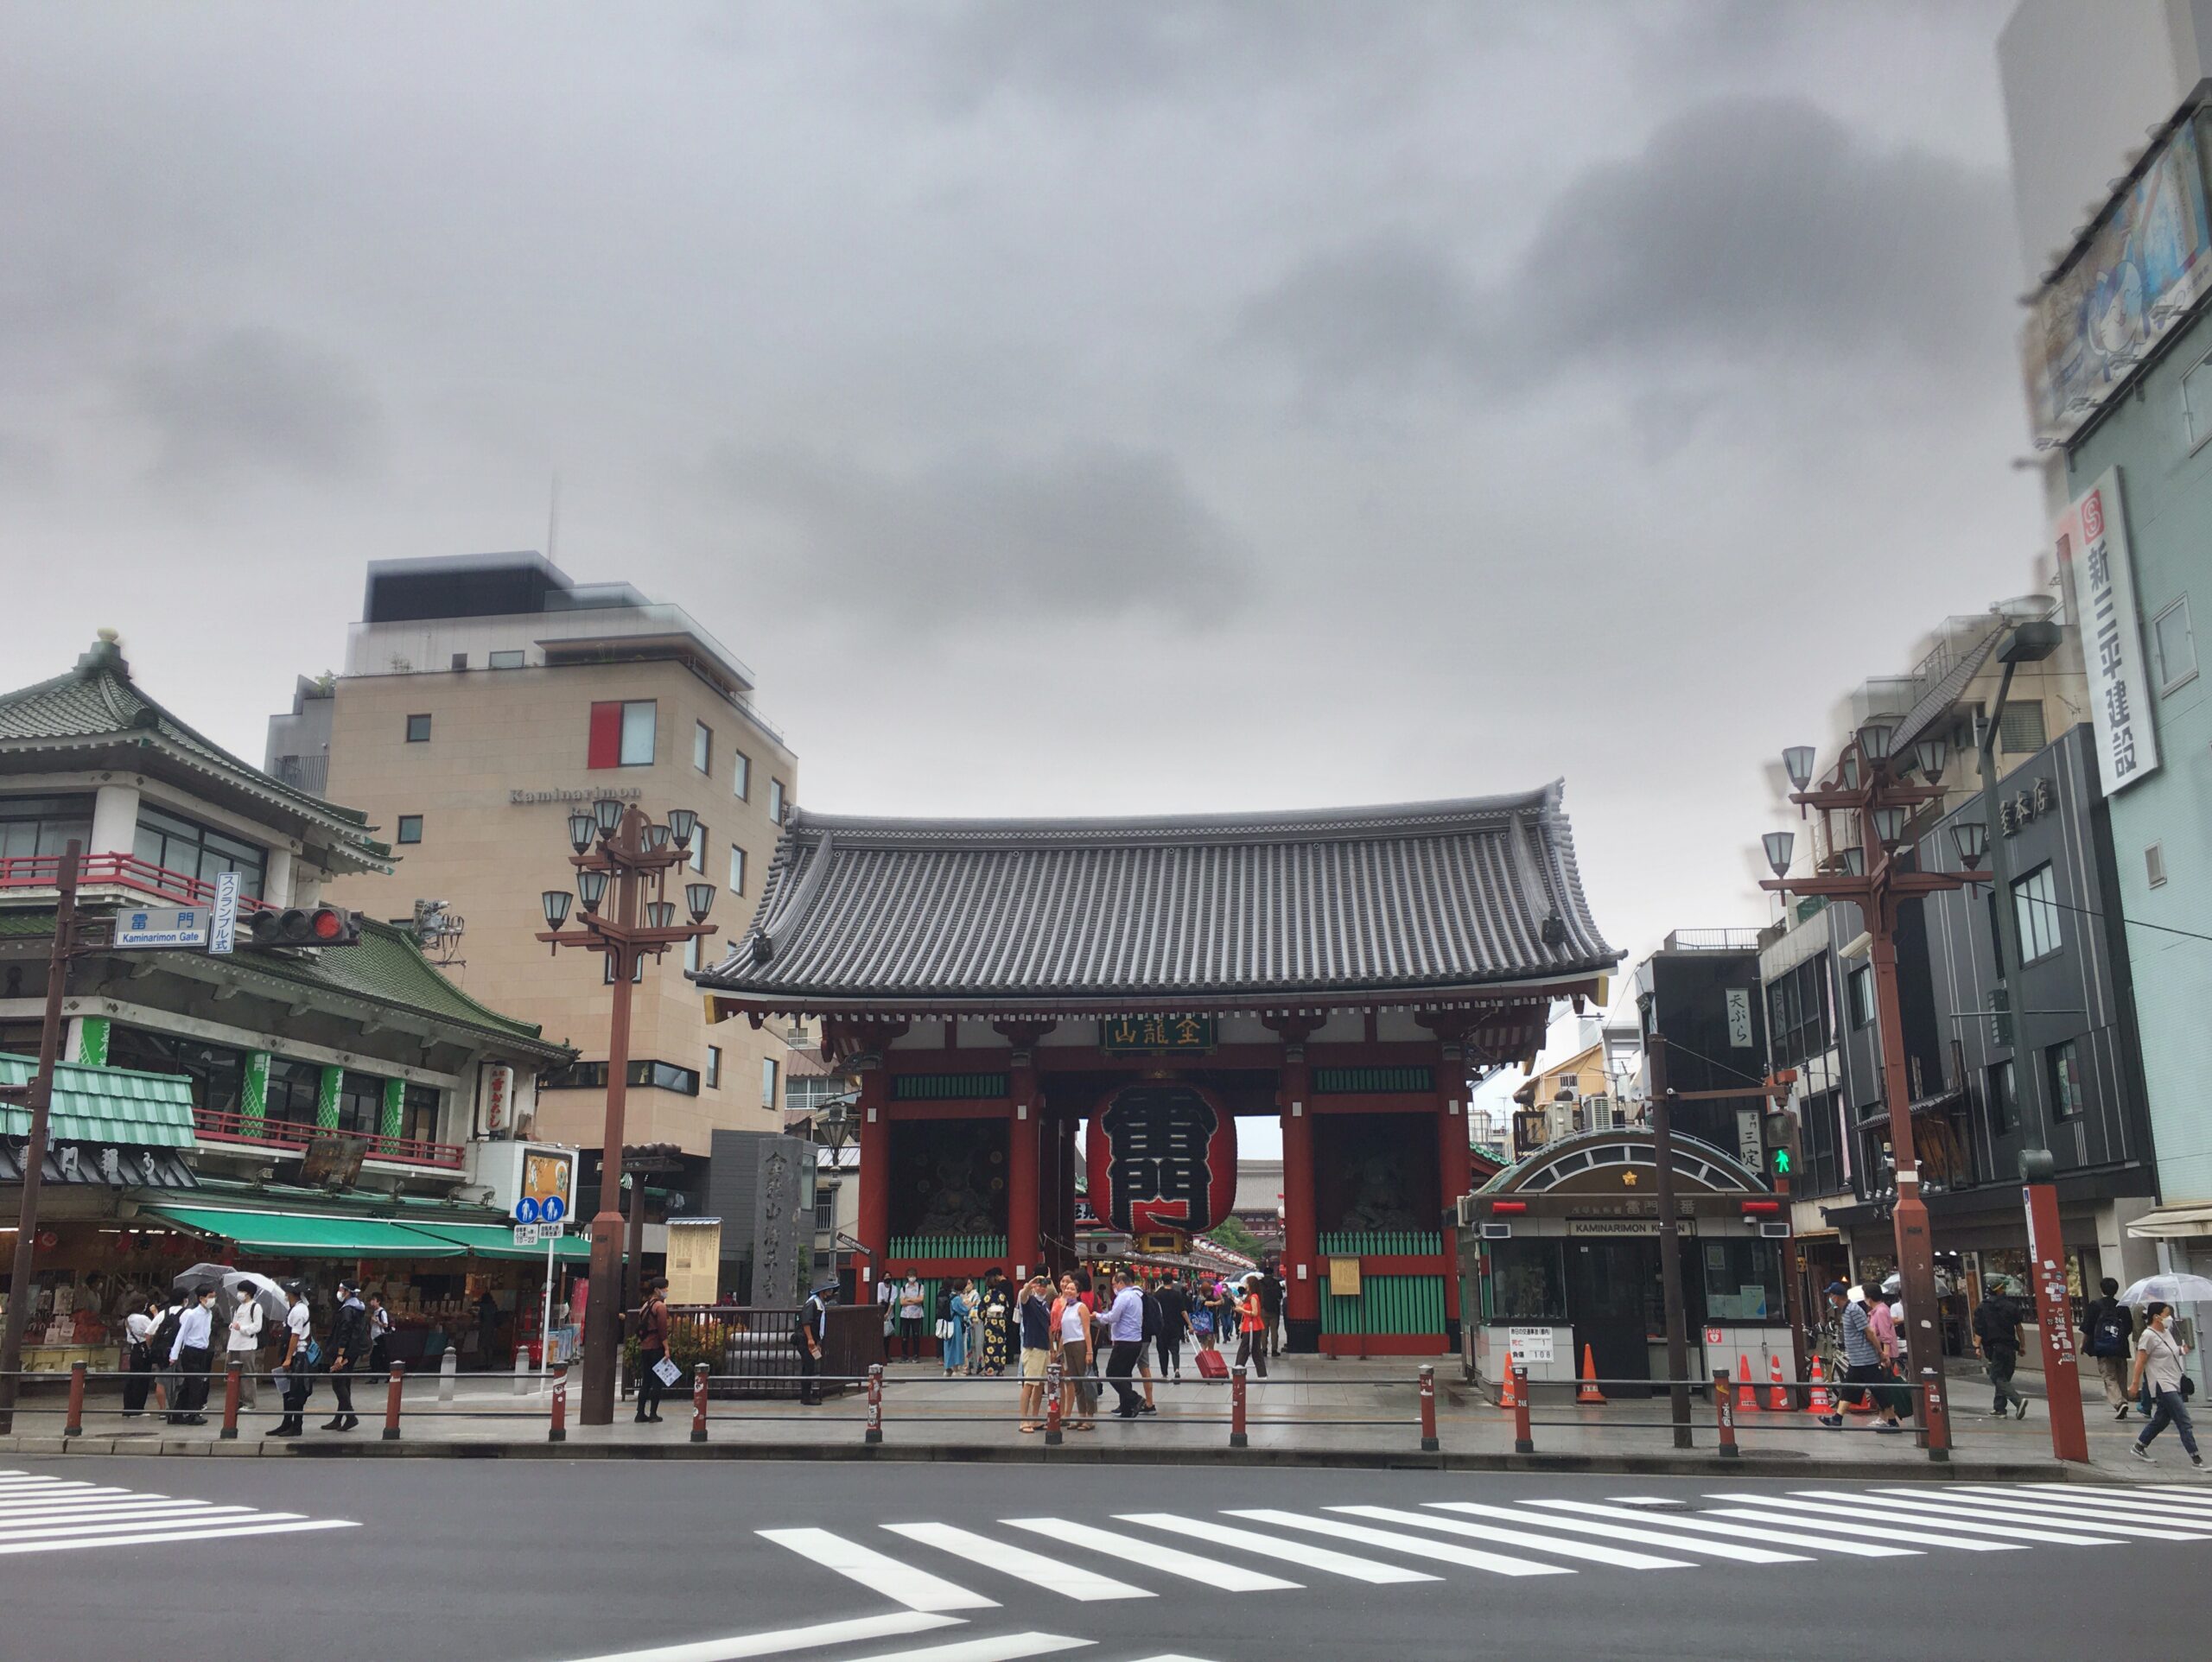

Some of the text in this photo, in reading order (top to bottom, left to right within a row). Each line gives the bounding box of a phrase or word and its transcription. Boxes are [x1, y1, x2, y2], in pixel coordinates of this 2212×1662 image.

[2088, 539, 2137, 778] 新三平建設
[510, 787, 642, 804] Kaminarimon
[131, 912, 194, 930] 雷門
[215, 876, 233, 949] スクランブル式
[123, 932, 199, 942] Kaminarimon Gate
[1102, 1086, 1219, 1233] 雷門
[1625, 1200, 1695, 1215] 雷門番
[1576, 1223, 1647, 1233] KAMINARIMON
